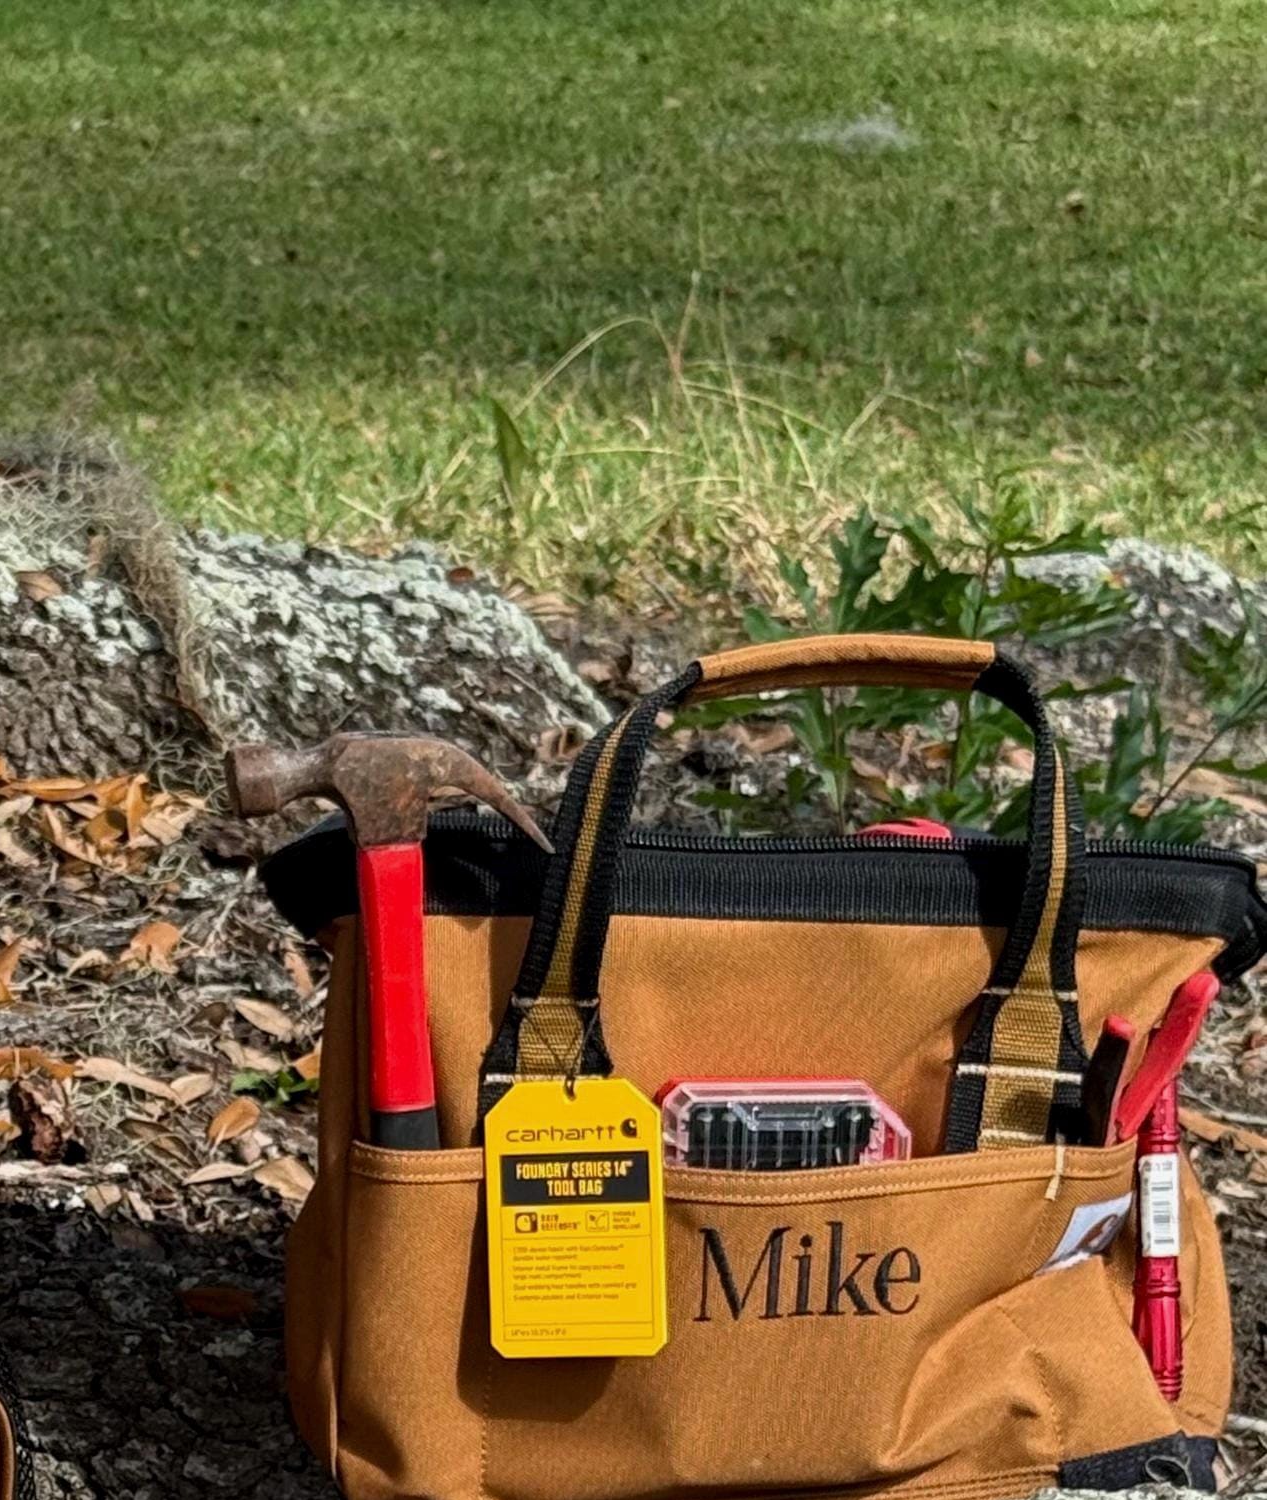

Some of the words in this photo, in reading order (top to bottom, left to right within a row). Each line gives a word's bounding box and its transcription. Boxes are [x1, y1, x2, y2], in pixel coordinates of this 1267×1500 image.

[505, 1125, 616, 1142] carhartt
[516, 1162, 569, 1179] FOUNDRY
[572, 1160, 612, 1178] SERIES
[614, 1160, 633, 1177] 14"
[547, 1180, 576, 1196] TOOL
[578, 1179, 603, 1196] BAG
[692, 1220, 921, 1321] Mike
